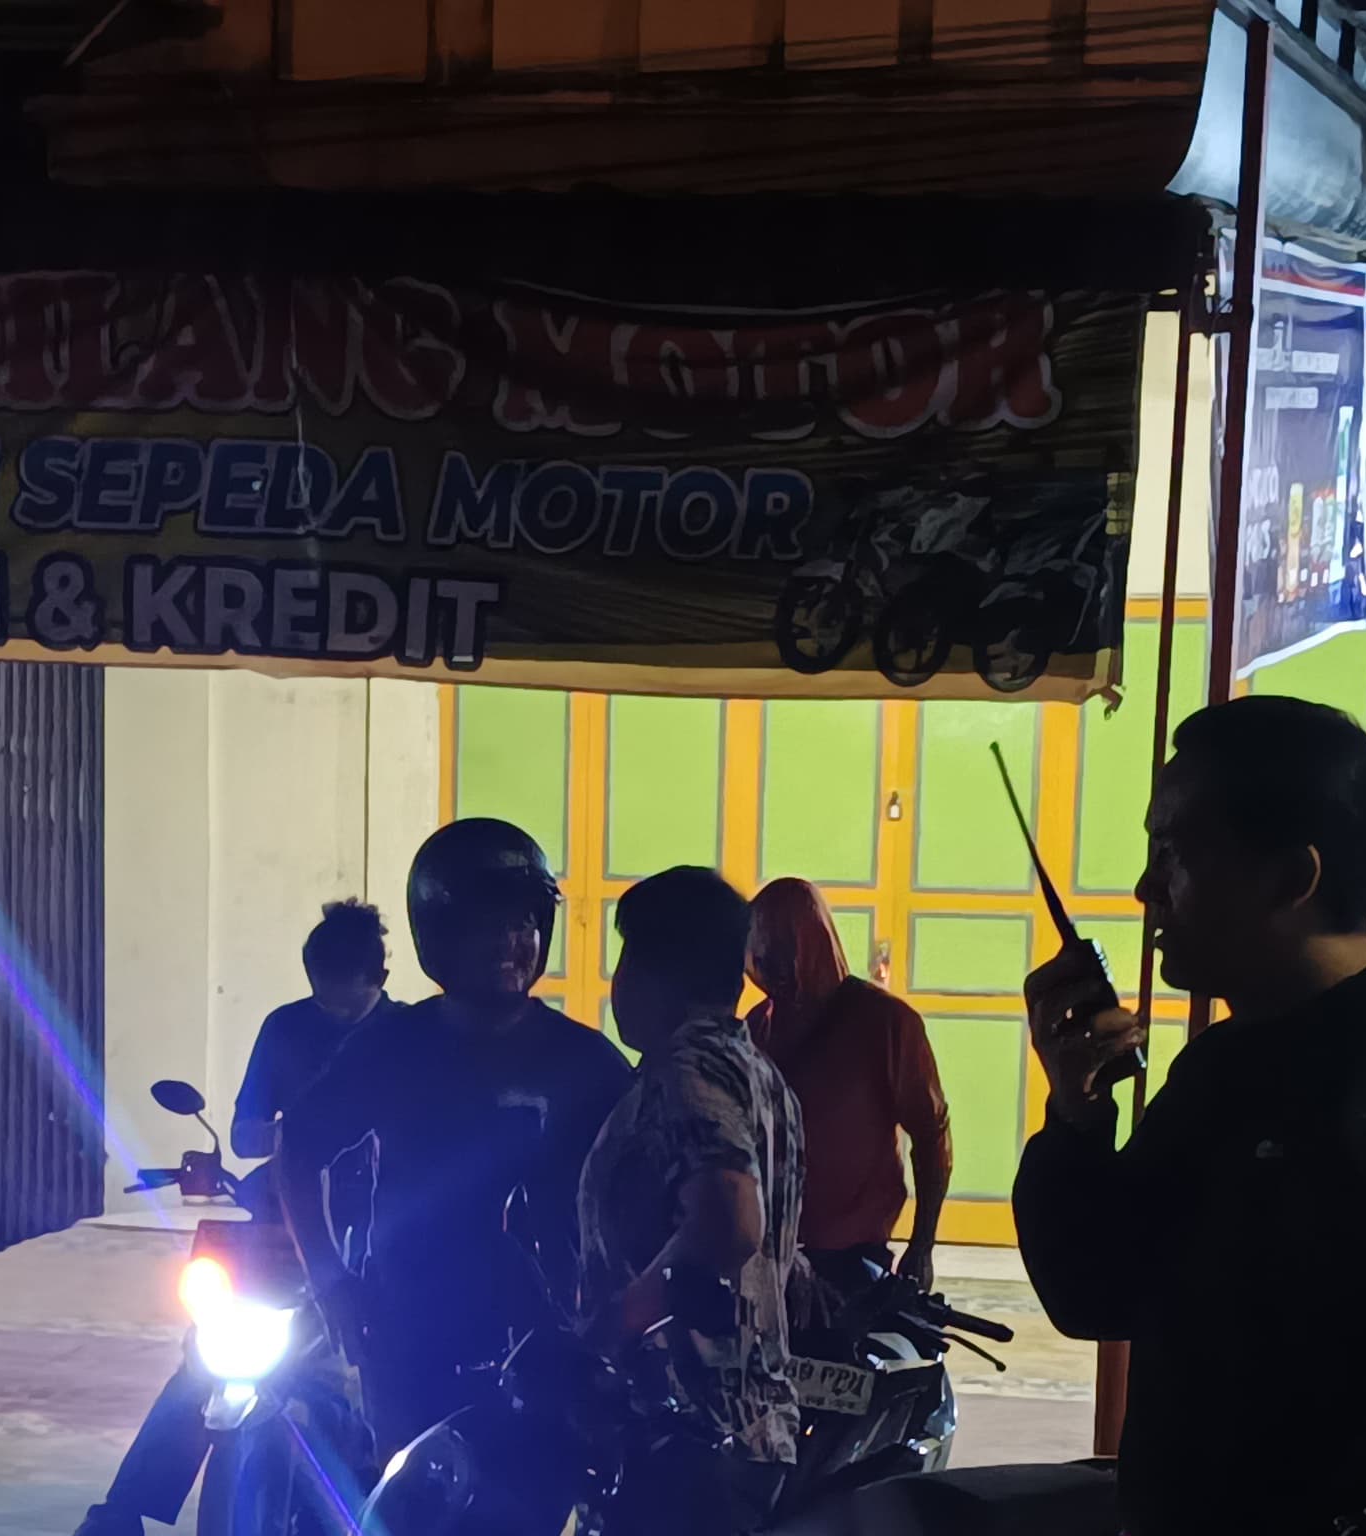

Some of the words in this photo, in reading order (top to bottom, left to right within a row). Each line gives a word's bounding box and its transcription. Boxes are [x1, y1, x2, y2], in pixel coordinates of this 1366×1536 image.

[11, 432, 406, 543] SEPEDA
[427, 452, 815, 561] MOTOR
[33, 549, 107, 649] &
[124, 556, 503, 670] KREDIT
